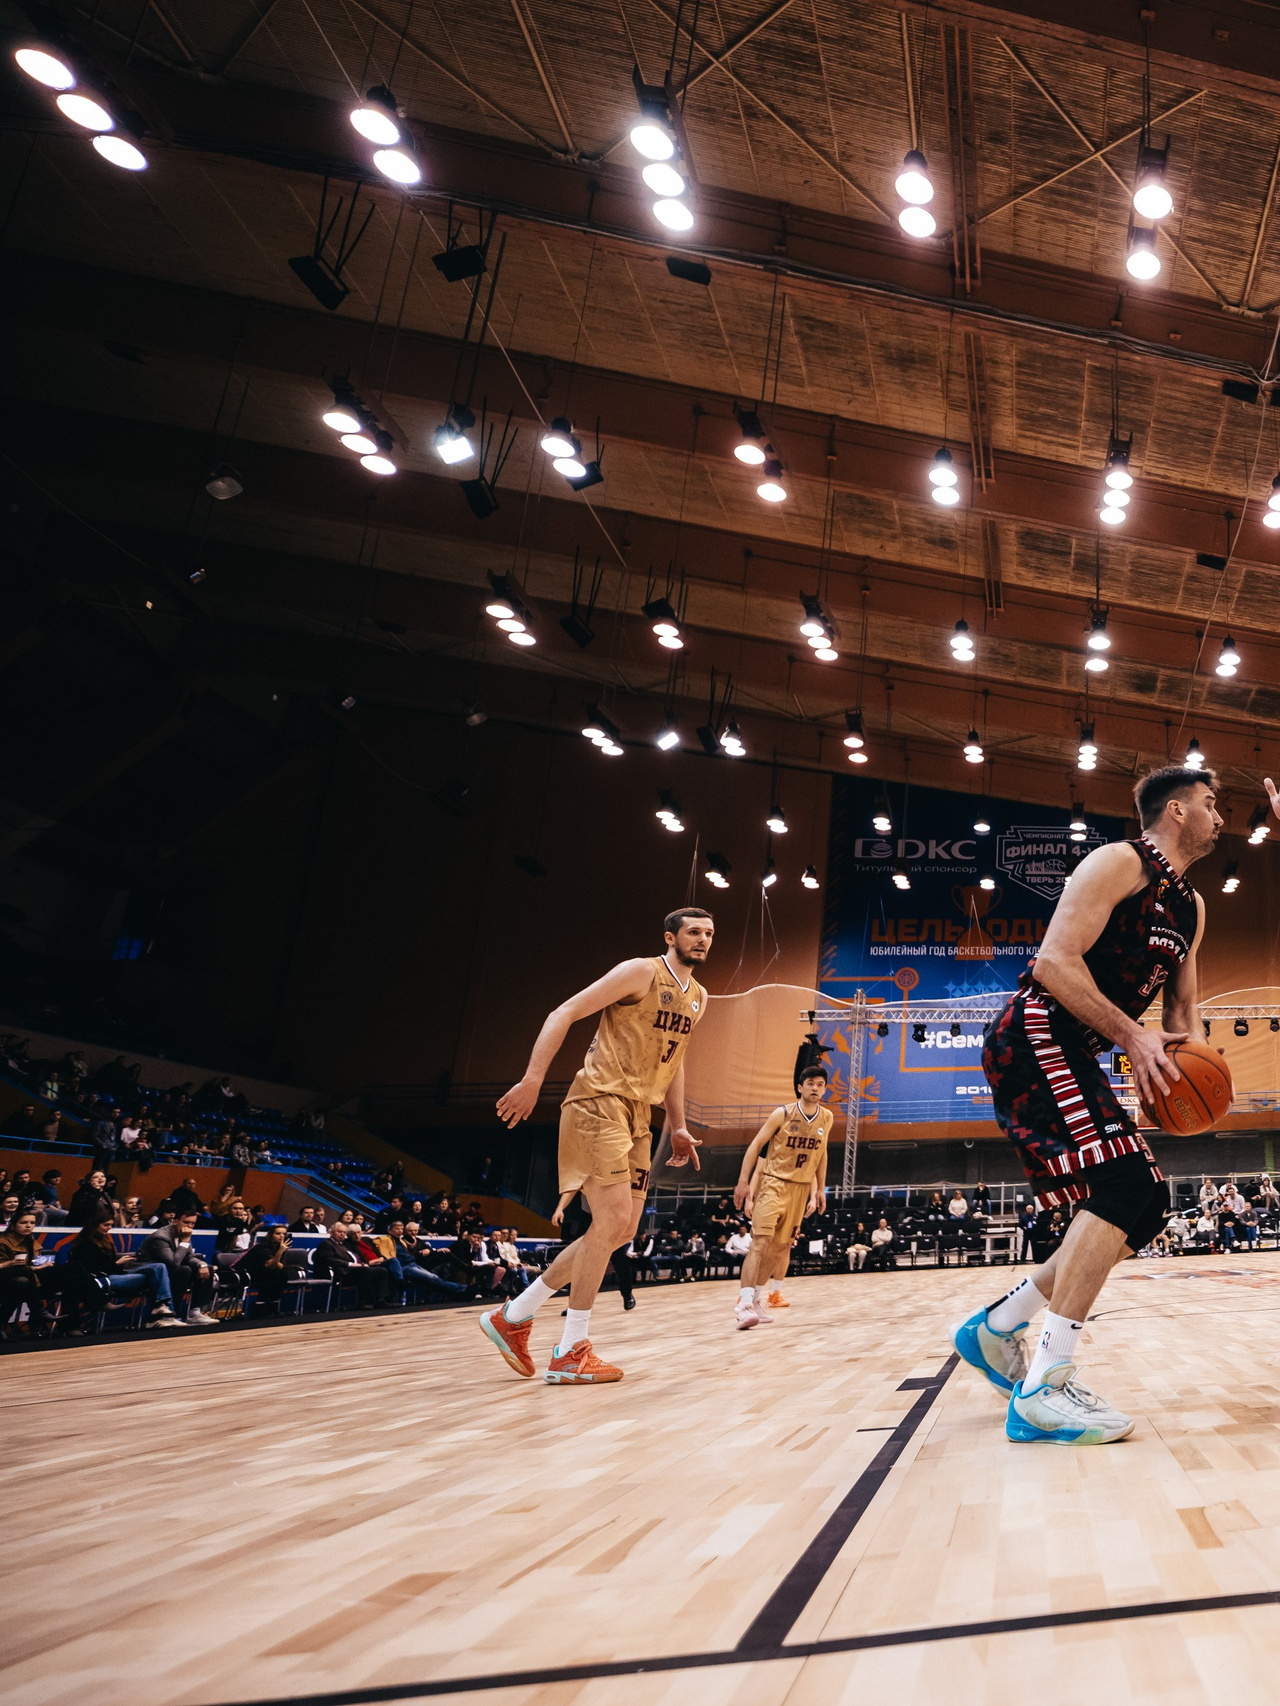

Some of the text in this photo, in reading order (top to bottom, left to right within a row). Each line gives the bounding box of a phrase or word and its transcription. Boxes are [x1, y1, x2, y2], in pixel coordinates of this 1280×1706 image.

[1023, 832, 1063, 840] ЧЕМПИОНАТ
[897, 840, 978, 860] DKC
[1005, 843, 1067, 859] ФИНАЛ
[854, 864, 978, 875] Титульй спонсор
[1025, 876, 1054, 884] ТВЕРЬ
[870, 918, 966, 945] ЦЕЛЬ
[870, 945, 927, 957] ЮБИЛЕЙНЫЙ
[928, 946, 946, 957] ГОД
[947, 946, 1024, 957] БАСКЕТБОЛЬНОГО
[653, 1010, 693, 1034] ЦИВ
[1120, 1061, 1132, 1074] 12
[1104, 1123, 1123, 1134] STK
[786, 1136, 821, 1151] ЦИВС
